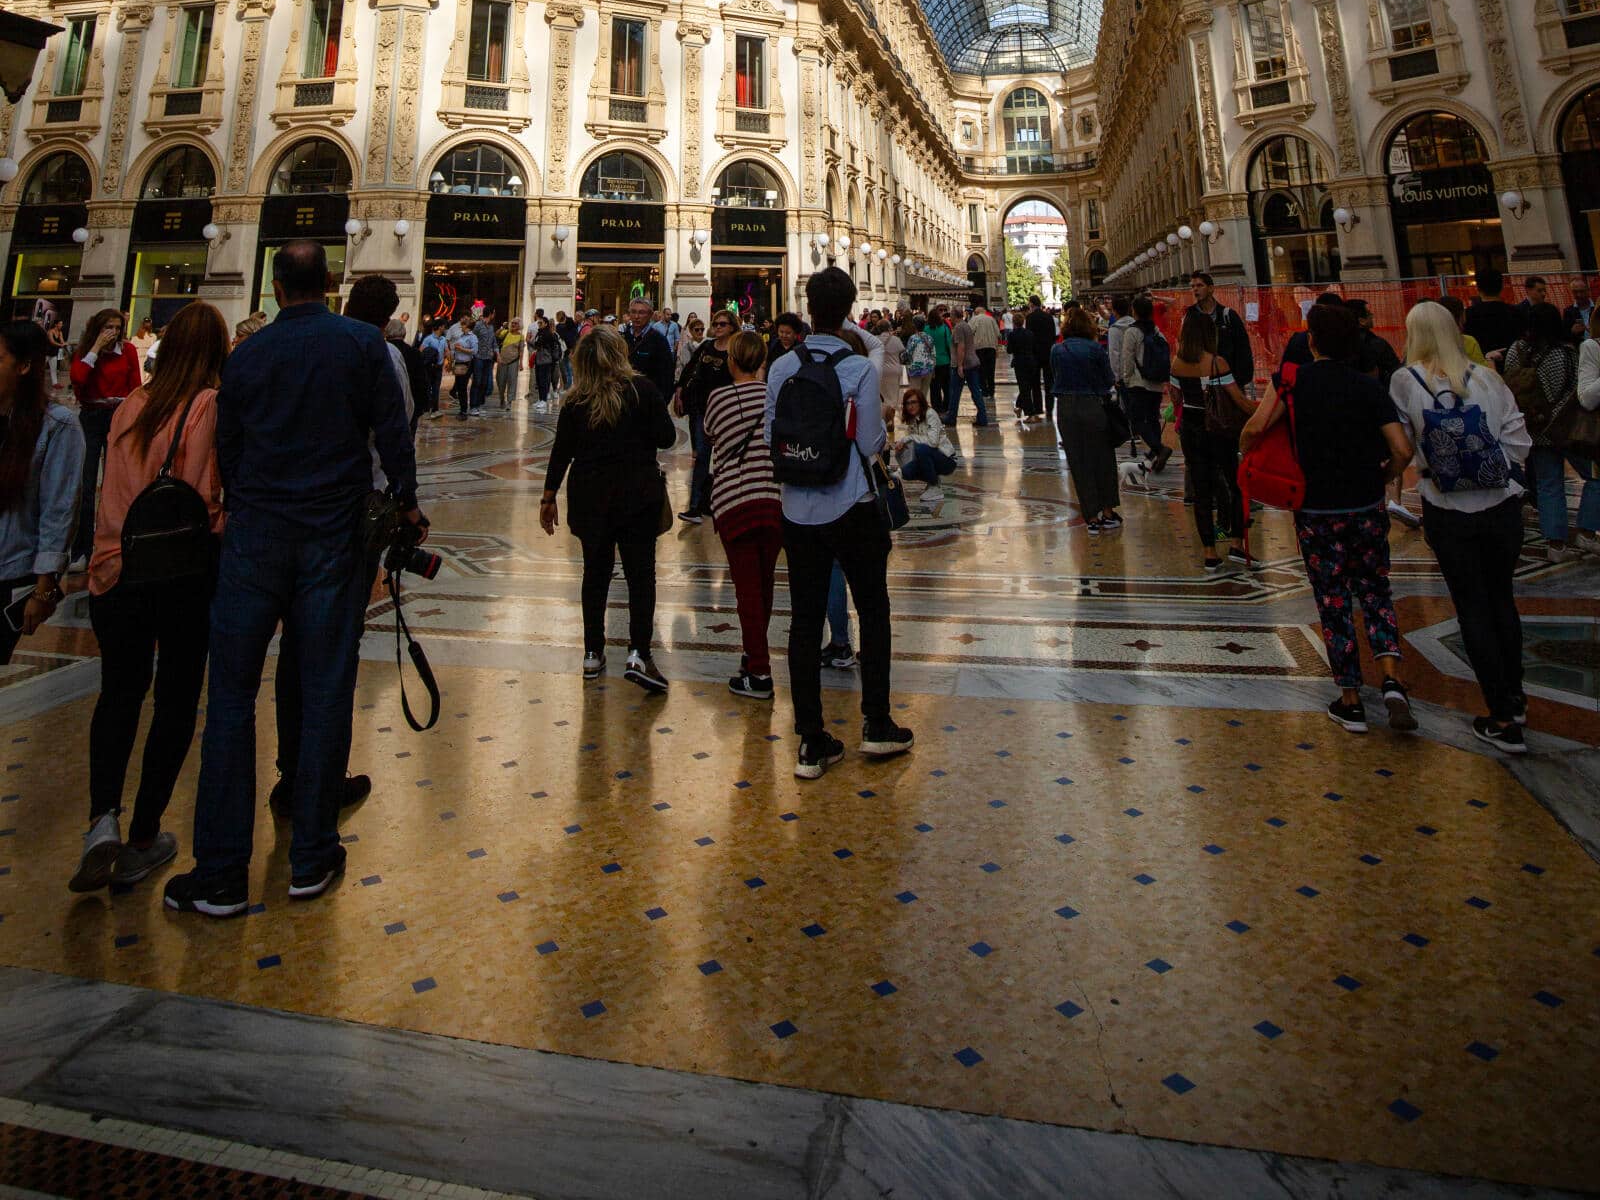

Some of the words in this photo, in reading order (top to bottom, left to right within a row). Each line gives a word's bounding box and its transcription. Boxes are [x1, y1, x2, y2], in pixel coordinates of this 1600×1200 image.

[1400, 189, 1433, 203] LOUIS
[1435, 184, 1488, 199] VUITTON
[453, 212, 499, 222] PRADA
[601, 218, 641, 228] PRADA
[731, 223, 766, 232] PRADA
